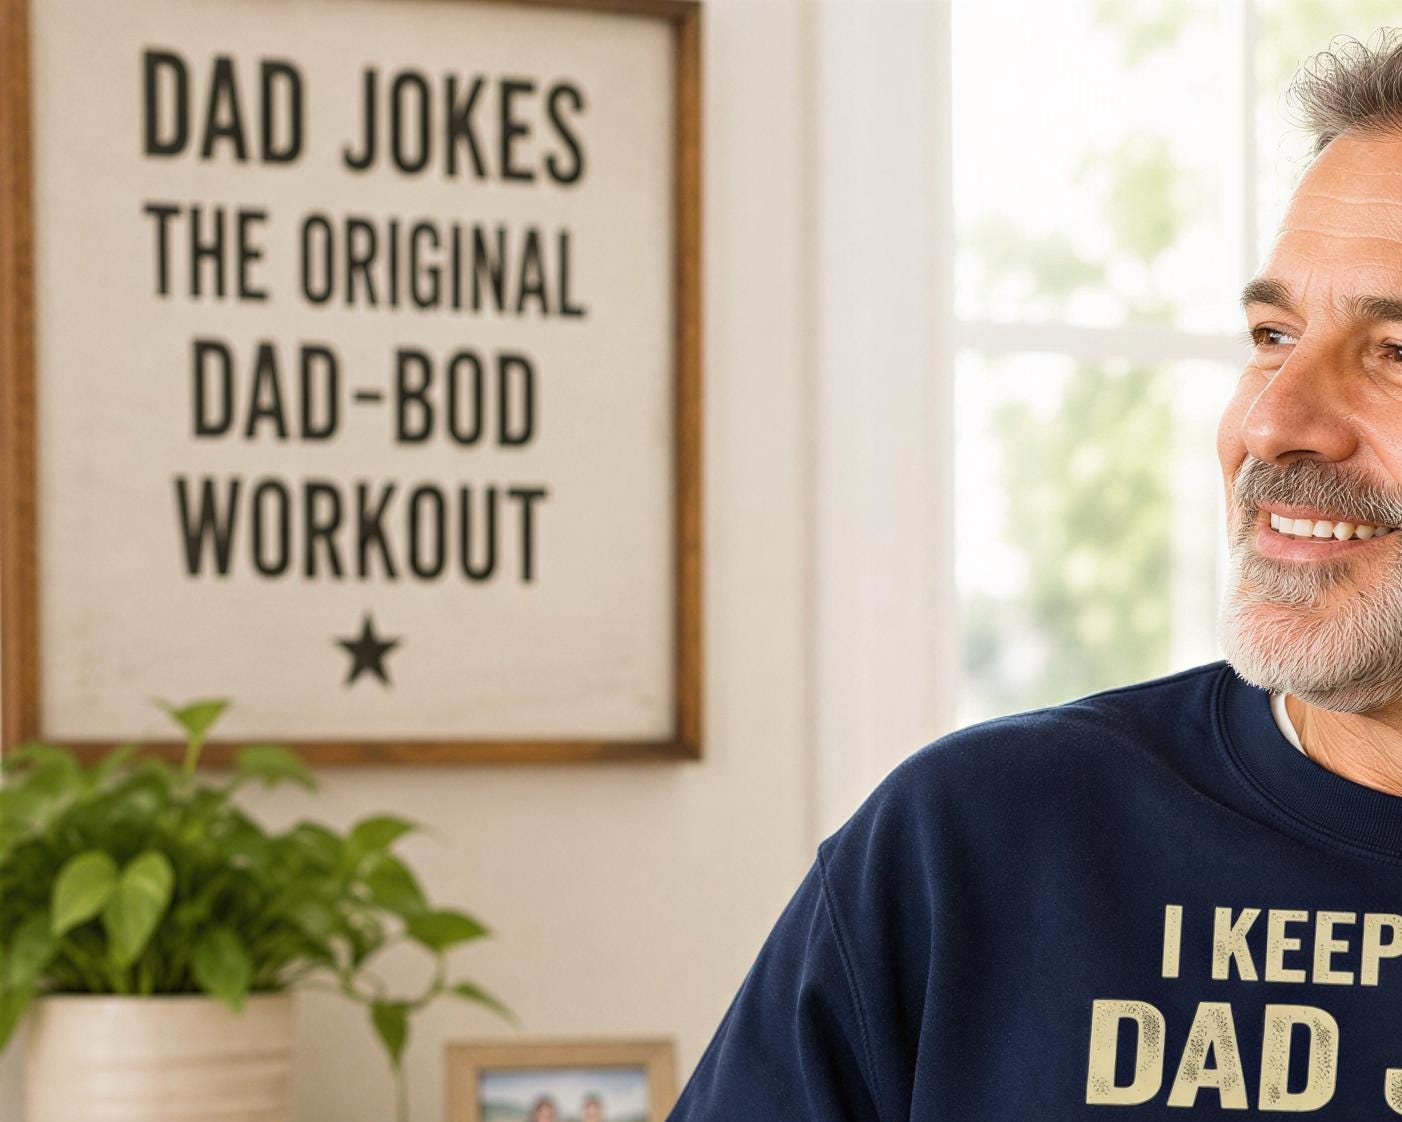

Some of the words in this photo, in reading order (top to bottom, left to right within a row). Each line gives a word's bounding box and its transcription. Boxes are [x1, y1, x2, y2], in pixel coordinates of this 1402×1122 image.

[142, 48, 304, 167] DAD
[343, 66, 587, 187] JOKES
[143, 203, 270, 301] THE
[302, 212, 587, 319] ORIGINAL
[192, 337, 537, 448] DAD-BOD
[174, 476, 549, 584] WORKOUT
[1162, 904, 1183, 979] I
[1086, 999, 1340, 1113] DAD
